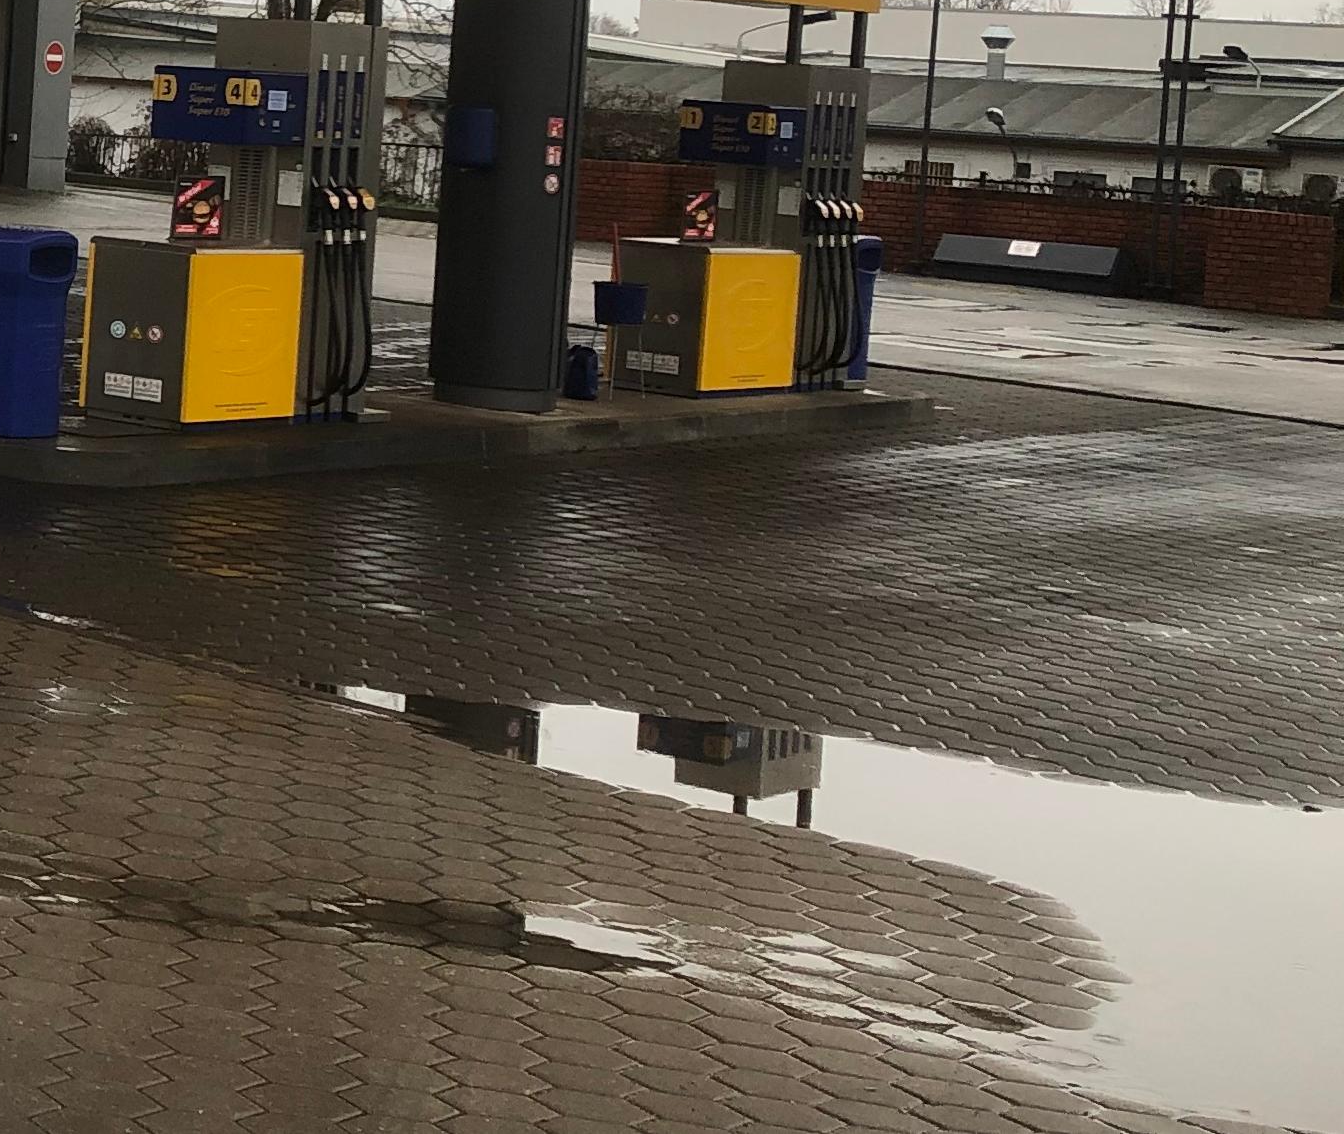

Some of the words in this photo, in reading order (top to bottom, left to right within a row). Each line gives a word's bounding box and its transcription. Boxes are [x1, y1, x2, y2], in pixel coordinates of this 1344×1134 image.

[161, 78, 172, 96] 3
[230, 83, 242, 101] 4
[250, 84, 259, 101] 4
[689, 111, 697, 124] 1
[751, 116, 761, 130] 2
